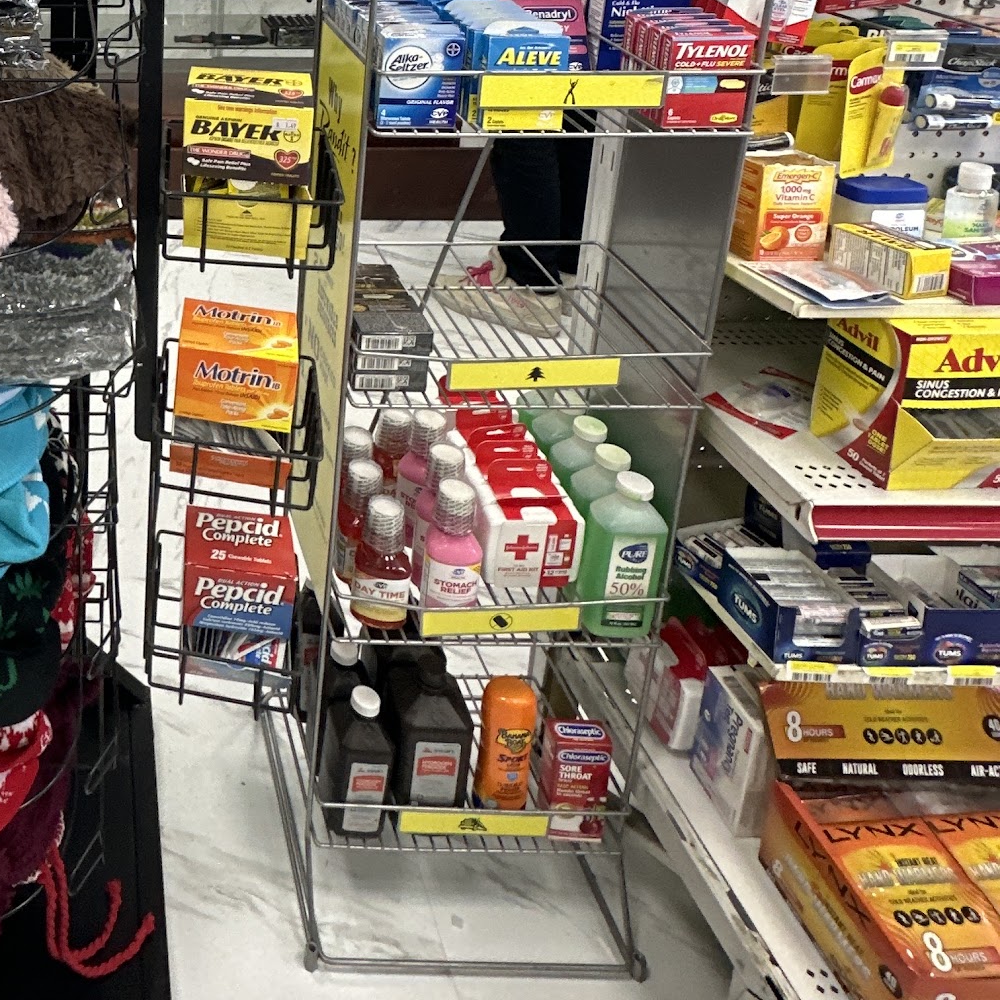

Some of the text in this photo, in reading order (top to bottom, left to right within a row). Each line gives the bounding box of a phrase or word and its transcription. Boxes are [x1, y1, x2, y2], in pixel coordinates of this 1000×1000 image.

[496, 47, 562, 67] ALEVE
[675, 42, 749, 60] TYLENOL
[393, 54, 421, 64] Alka-
[195, 73, 284, 86] BAYER
[191, 119, 281, 142] BAYER
[279, 154, 292, 164] 325
[776, 172, 819, 180] Emergen-C
[792, 213, 814, 221] Orange
[192, 305, 273, 326] Motrin
[836, 318, 880, 352] Advil
[933, 347, 1000, 373] Adv
[193, 360, 273, 389] Motrin
[868, 365, 886, 382] PAIN
[192, 380, 224, 390] Ibuprofen
[916, 380, 950, 390] SINUS
[915, 388, 996, 399] CONGESTION &
[847, 448, 860, 462] 50
[195, 512, 281, 538] Pepcid
[202, 527, 273, 547] Complete
[210, 549, 227, 560] 25
[616, 566, 647, 576] Rubbing
[217, 577, 234, 585] DUAL
[434, 579, 478, 589] STOMACH
[194, 576, 285, 606] Pepcid
[355, 582, 406, 600] DAY TIME
[440, 587, 472, 595] RELIEF
[609, 582, 644, 597] 50%
[200, 595, 273, 616] Complete
[734, 593, 758, 624] TUMS
[558, 726, 602, 736] Chloraseptic
[786, 710, 834, 743] 8 HOURS
[561, 752, 607, 762] Chloraseptic
[560, 764, 583, 772] SORE
[797, 762, 817, 774] SAFE
[842, 762, 879, 775] NATURAL
[902, 763, 944, 777] ODORLESS
[559, 771, 593, 780] THROAT
[823, 823, 926, 843] LYNX
[922, 931, 953, 972] 8
